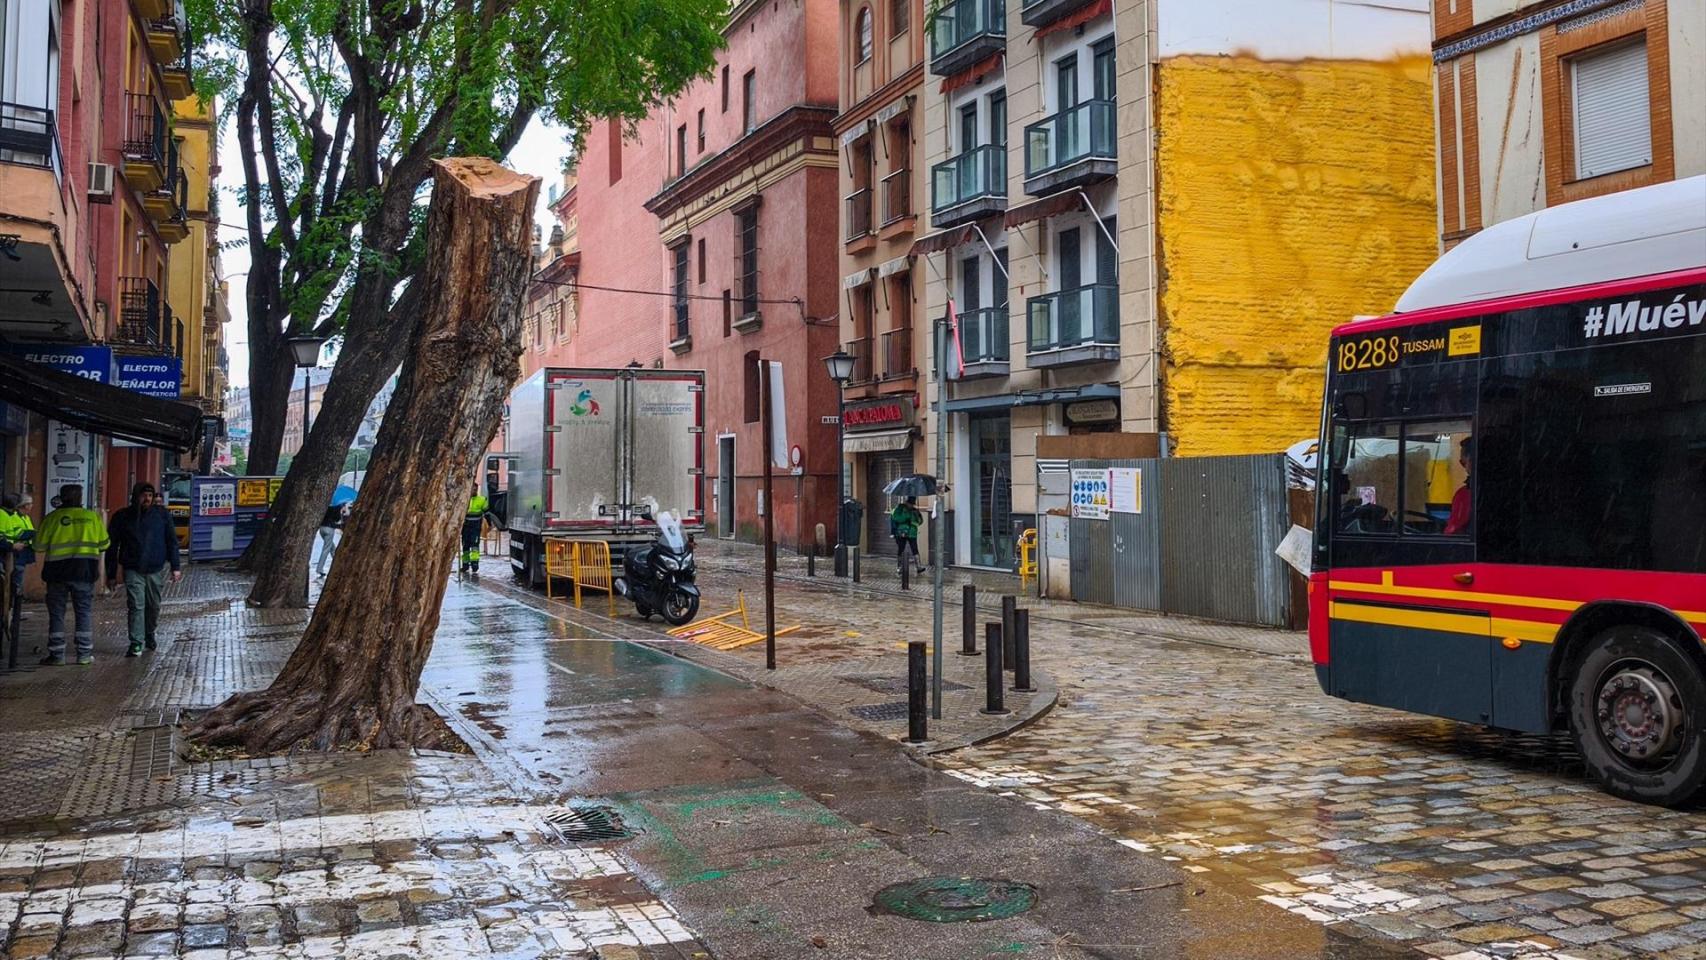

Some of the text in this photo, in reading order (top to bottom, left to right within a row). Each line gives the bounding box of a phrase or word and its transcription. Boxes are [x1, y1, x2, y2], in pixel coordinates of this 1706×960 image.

[1402, 338, 1445, 353] TUSSAM
[24, 353, 85, 365] ELECTRO
[123, 364, 168, 373] ELECTRO
